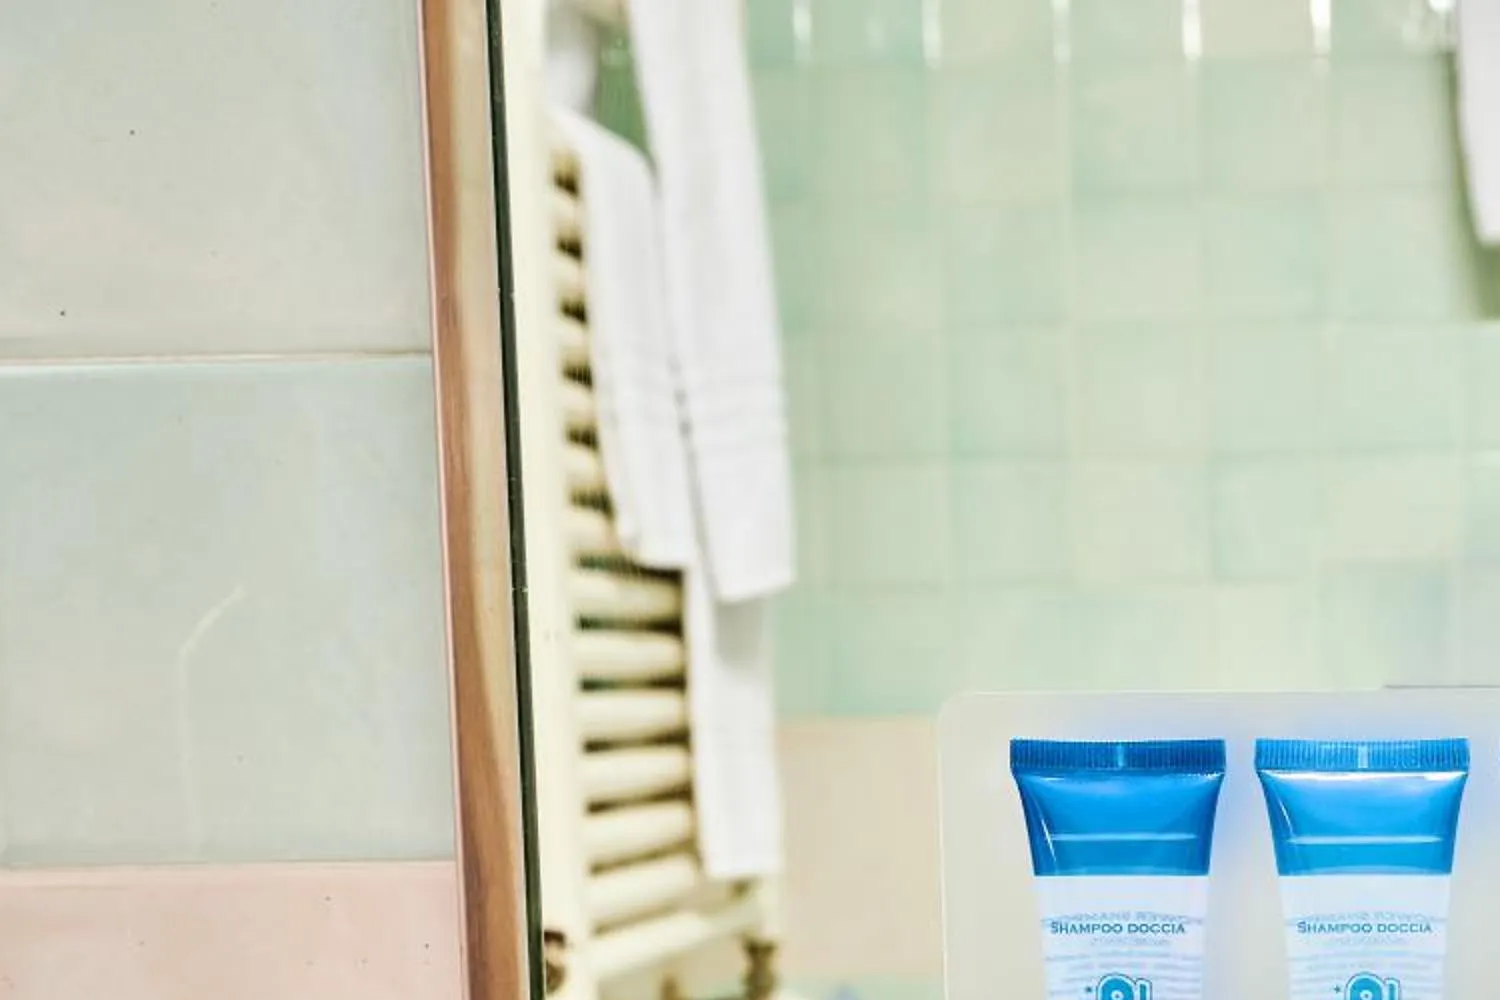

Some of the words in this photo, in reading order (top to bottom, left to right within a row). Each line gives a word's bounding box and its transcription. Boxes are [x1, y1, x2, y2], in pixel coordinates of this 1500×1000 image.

[1050, 921, 1123, 934] SHAMPOO
[1127, 922, 1186, 934] DOCCIA
[1297, 921, 1373, 933] SHAMPOO
[1377, 922, 1432, 933] DOCCIA
